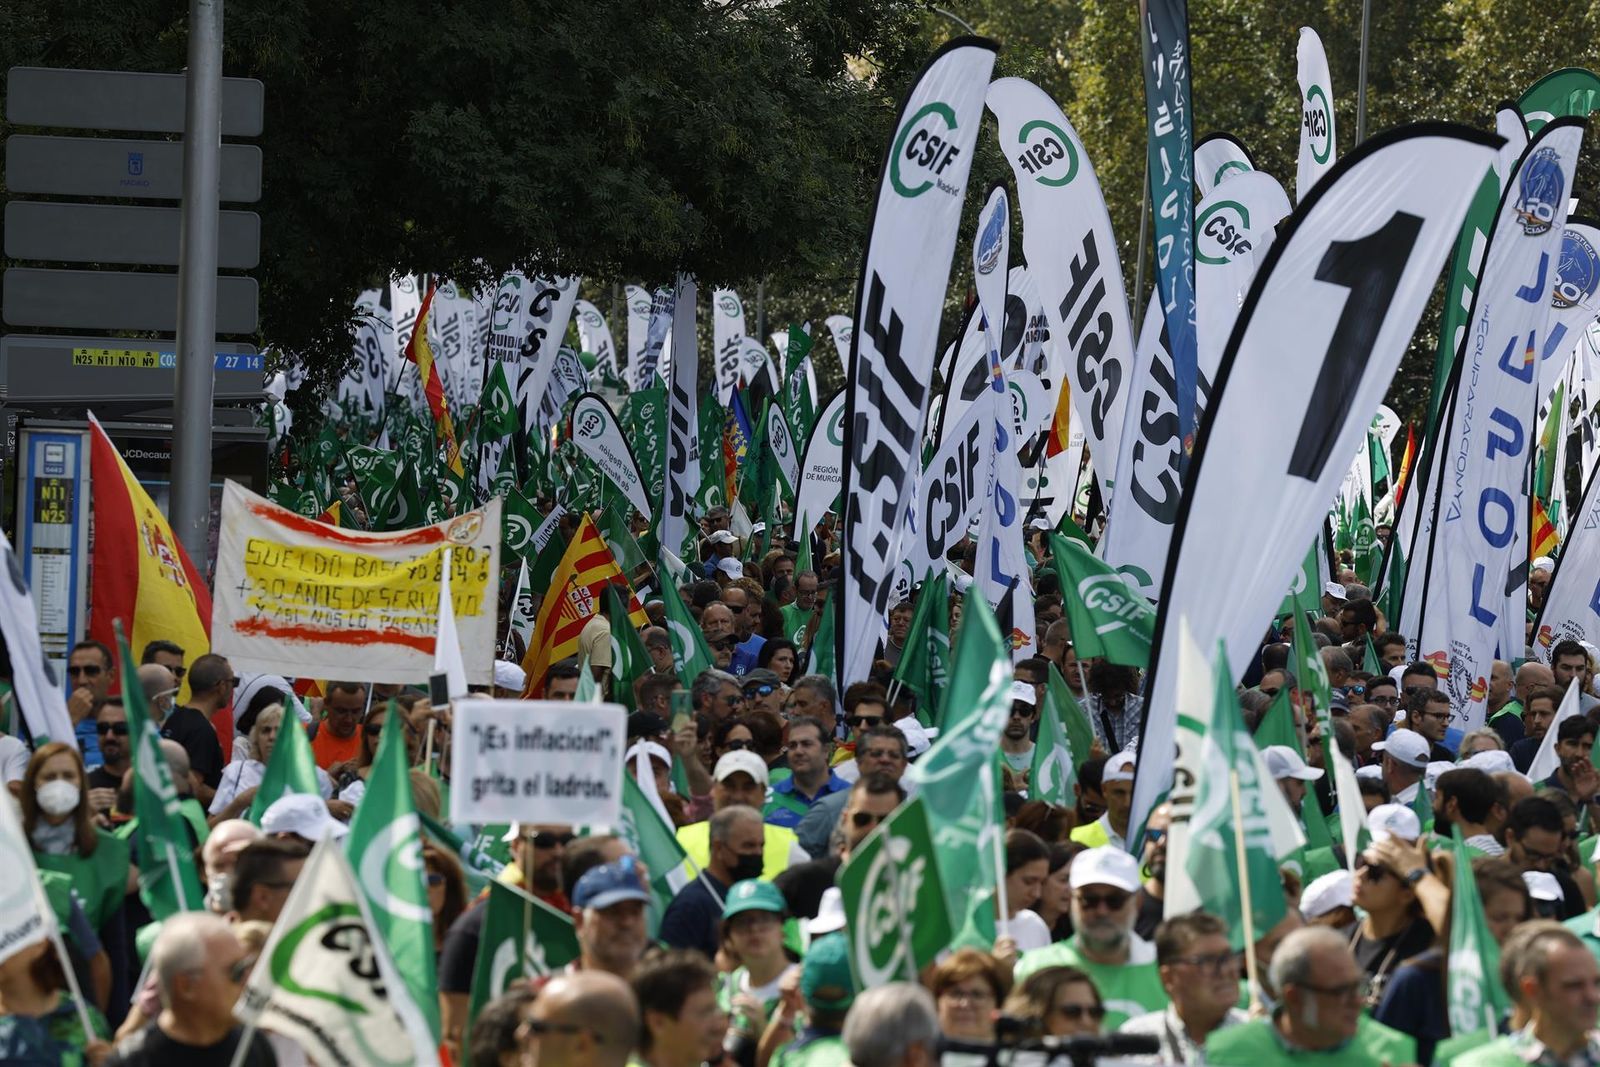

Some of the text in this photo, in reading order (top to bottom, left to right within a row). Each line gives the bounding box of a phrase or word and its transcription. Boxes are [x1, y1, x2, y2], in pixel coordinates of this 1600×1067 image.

[905, 128, 960, 176] CSIF
[1204, 215, 1253, 256] CSIF
[75, 354, 93, 365] N25
[97, 355, 114, 366] N11
[118, 355, 136, 367] N10
[142, 356, 155, 367] N9
[225, 355, 239, 368] 27
[246, 356, 260, 369] 14
[1287, 209, 1426, 484] 1
[122, 449, 171, 460] JCDecaux
[849, 268, 926, 616] CSIF
[805, 472, 842, 483] DE MURCIA
[812, 463, 839, 474] REGIÓN
[41, 486, 65, 500] N11
[925, 419, 980, 560] CSIF
[41, 510, 66, 523] N25
[245, 538, 343, 578] SUELDO
[379, 587, 479, 617] SERVIIO
[1085, 587, 1149, 621] CSIF
[471, 771, 611, 802] grita el ladrón.
